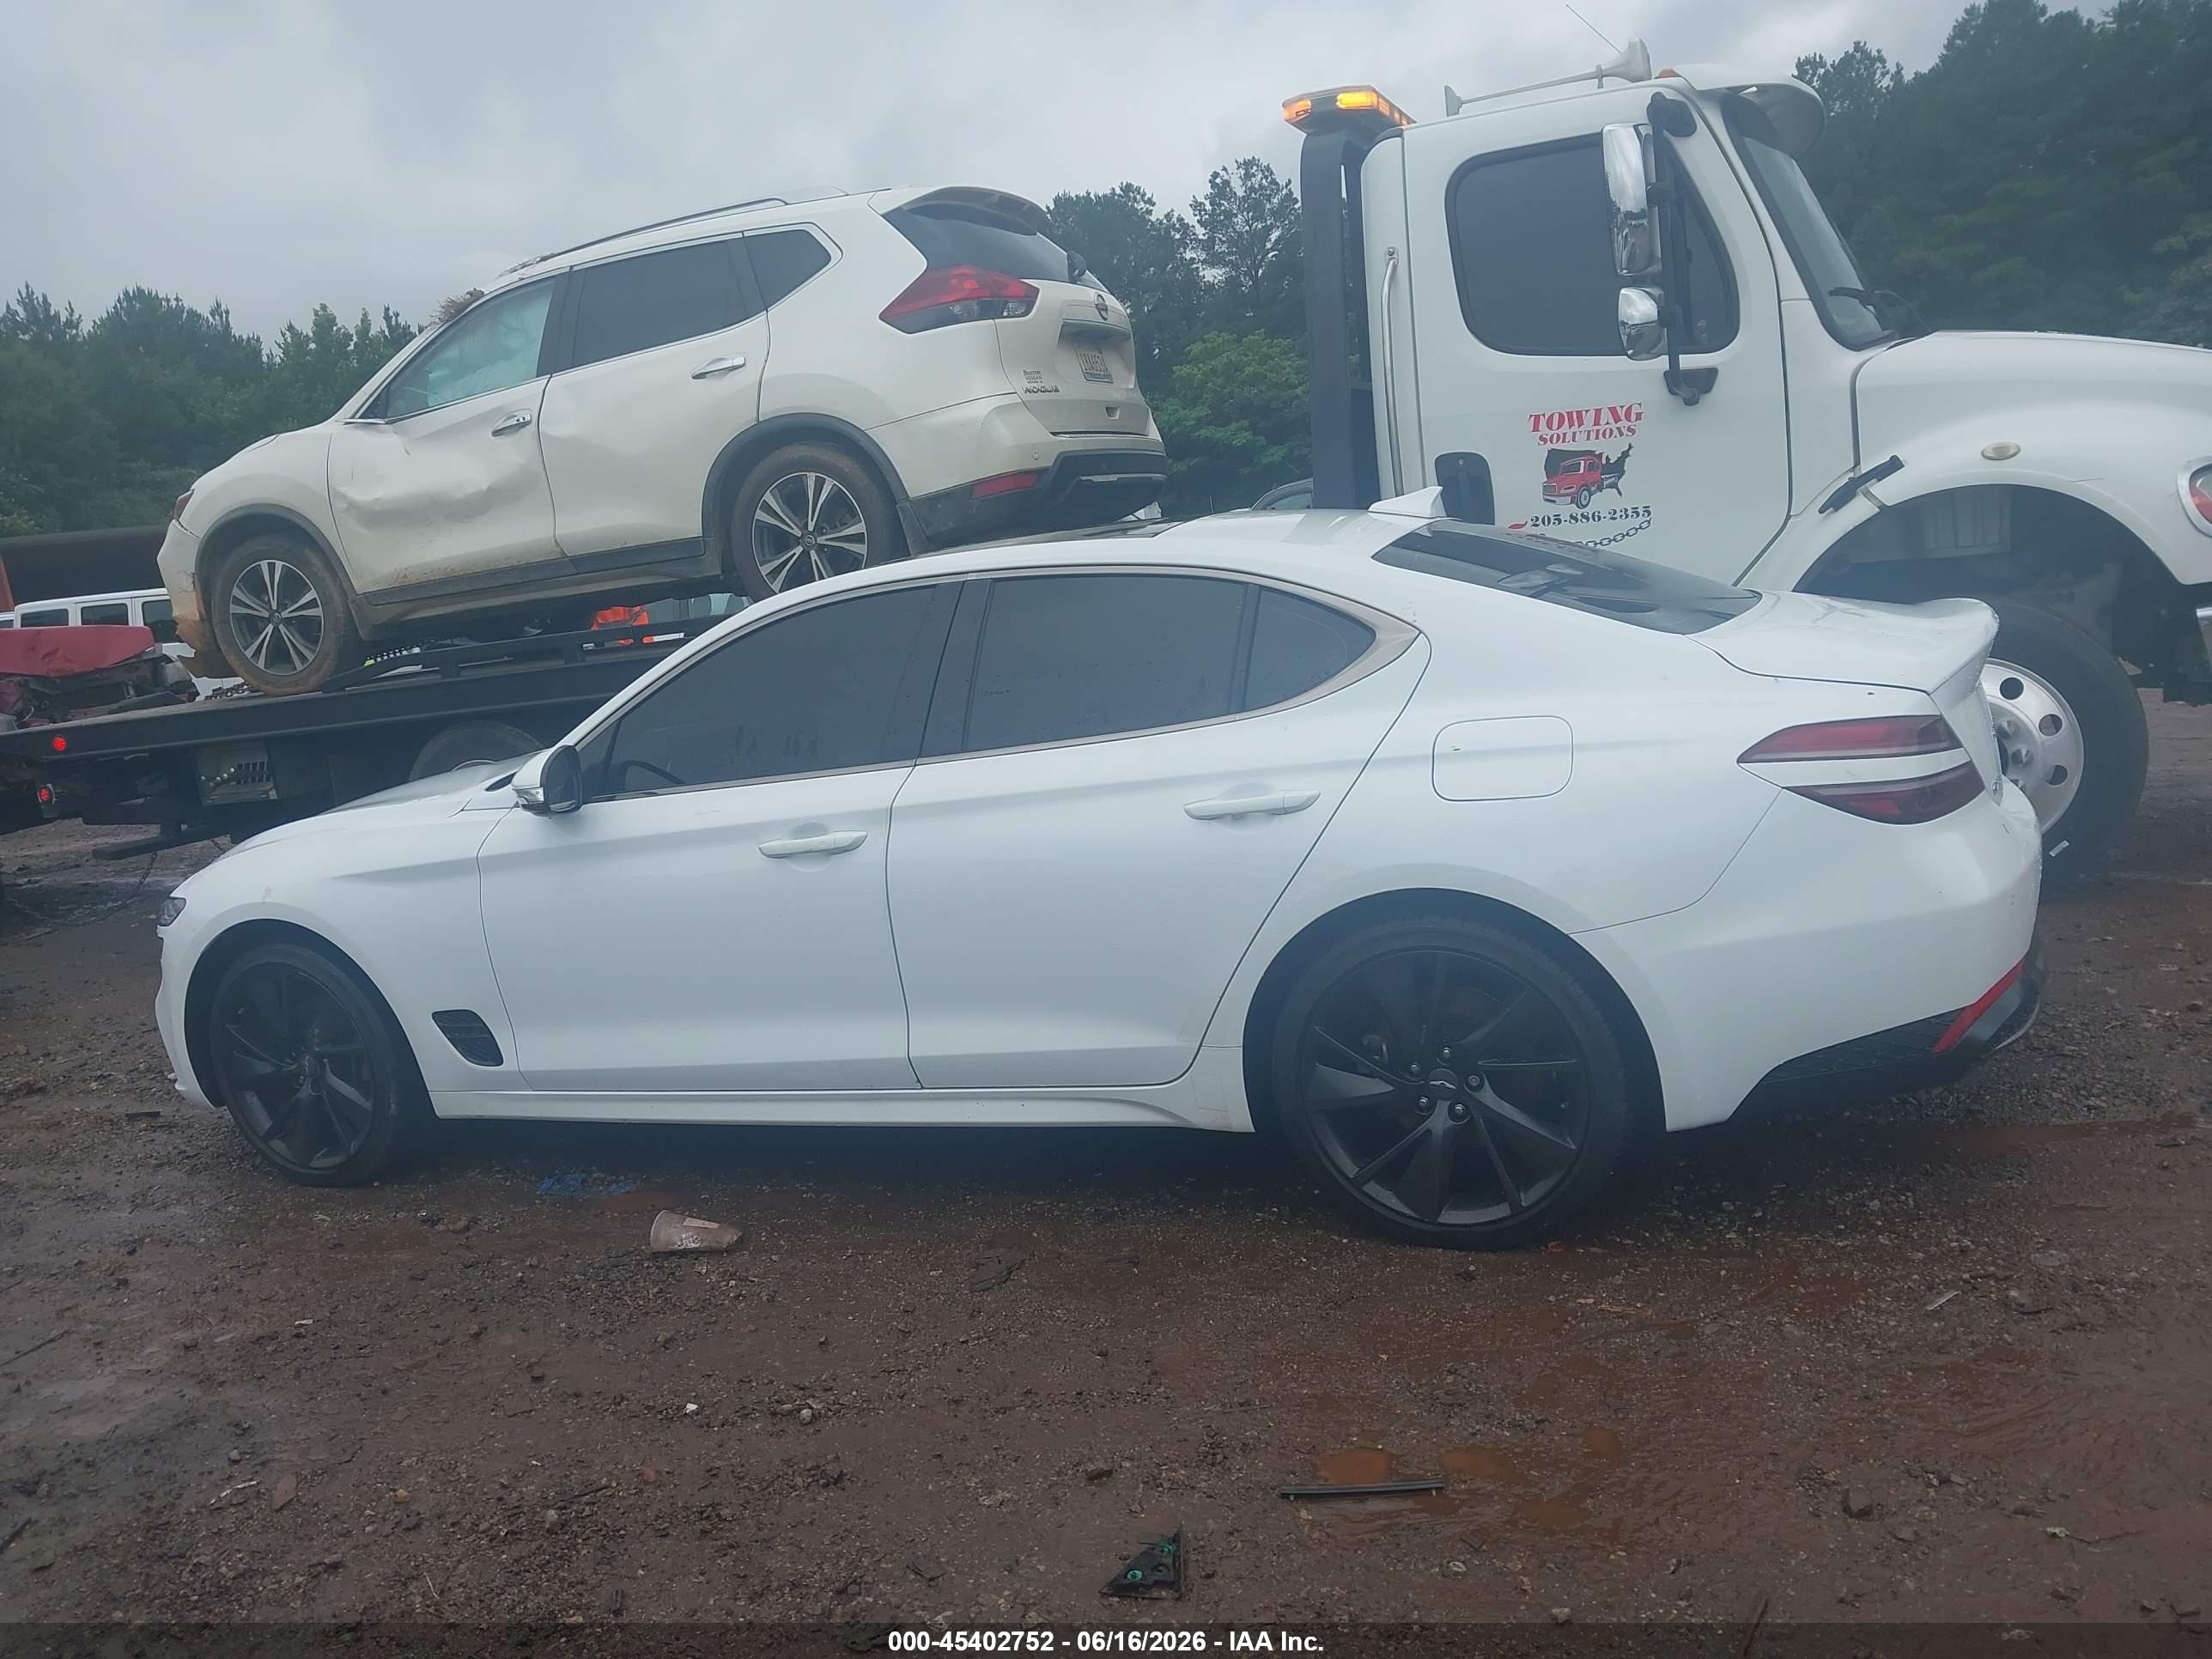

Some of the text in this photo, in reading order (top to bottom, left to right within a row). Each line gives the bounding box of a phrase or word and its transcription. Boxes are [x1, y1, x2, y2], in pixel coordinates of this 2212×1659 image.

[1022, 385, 1060, 394] ROGUE
[1528, 402, 1644, 433] TOWING
[1538, 424, 1637, 446] SOLUTIONS
[1530, 505, 1652, 528] 205-886-2355
